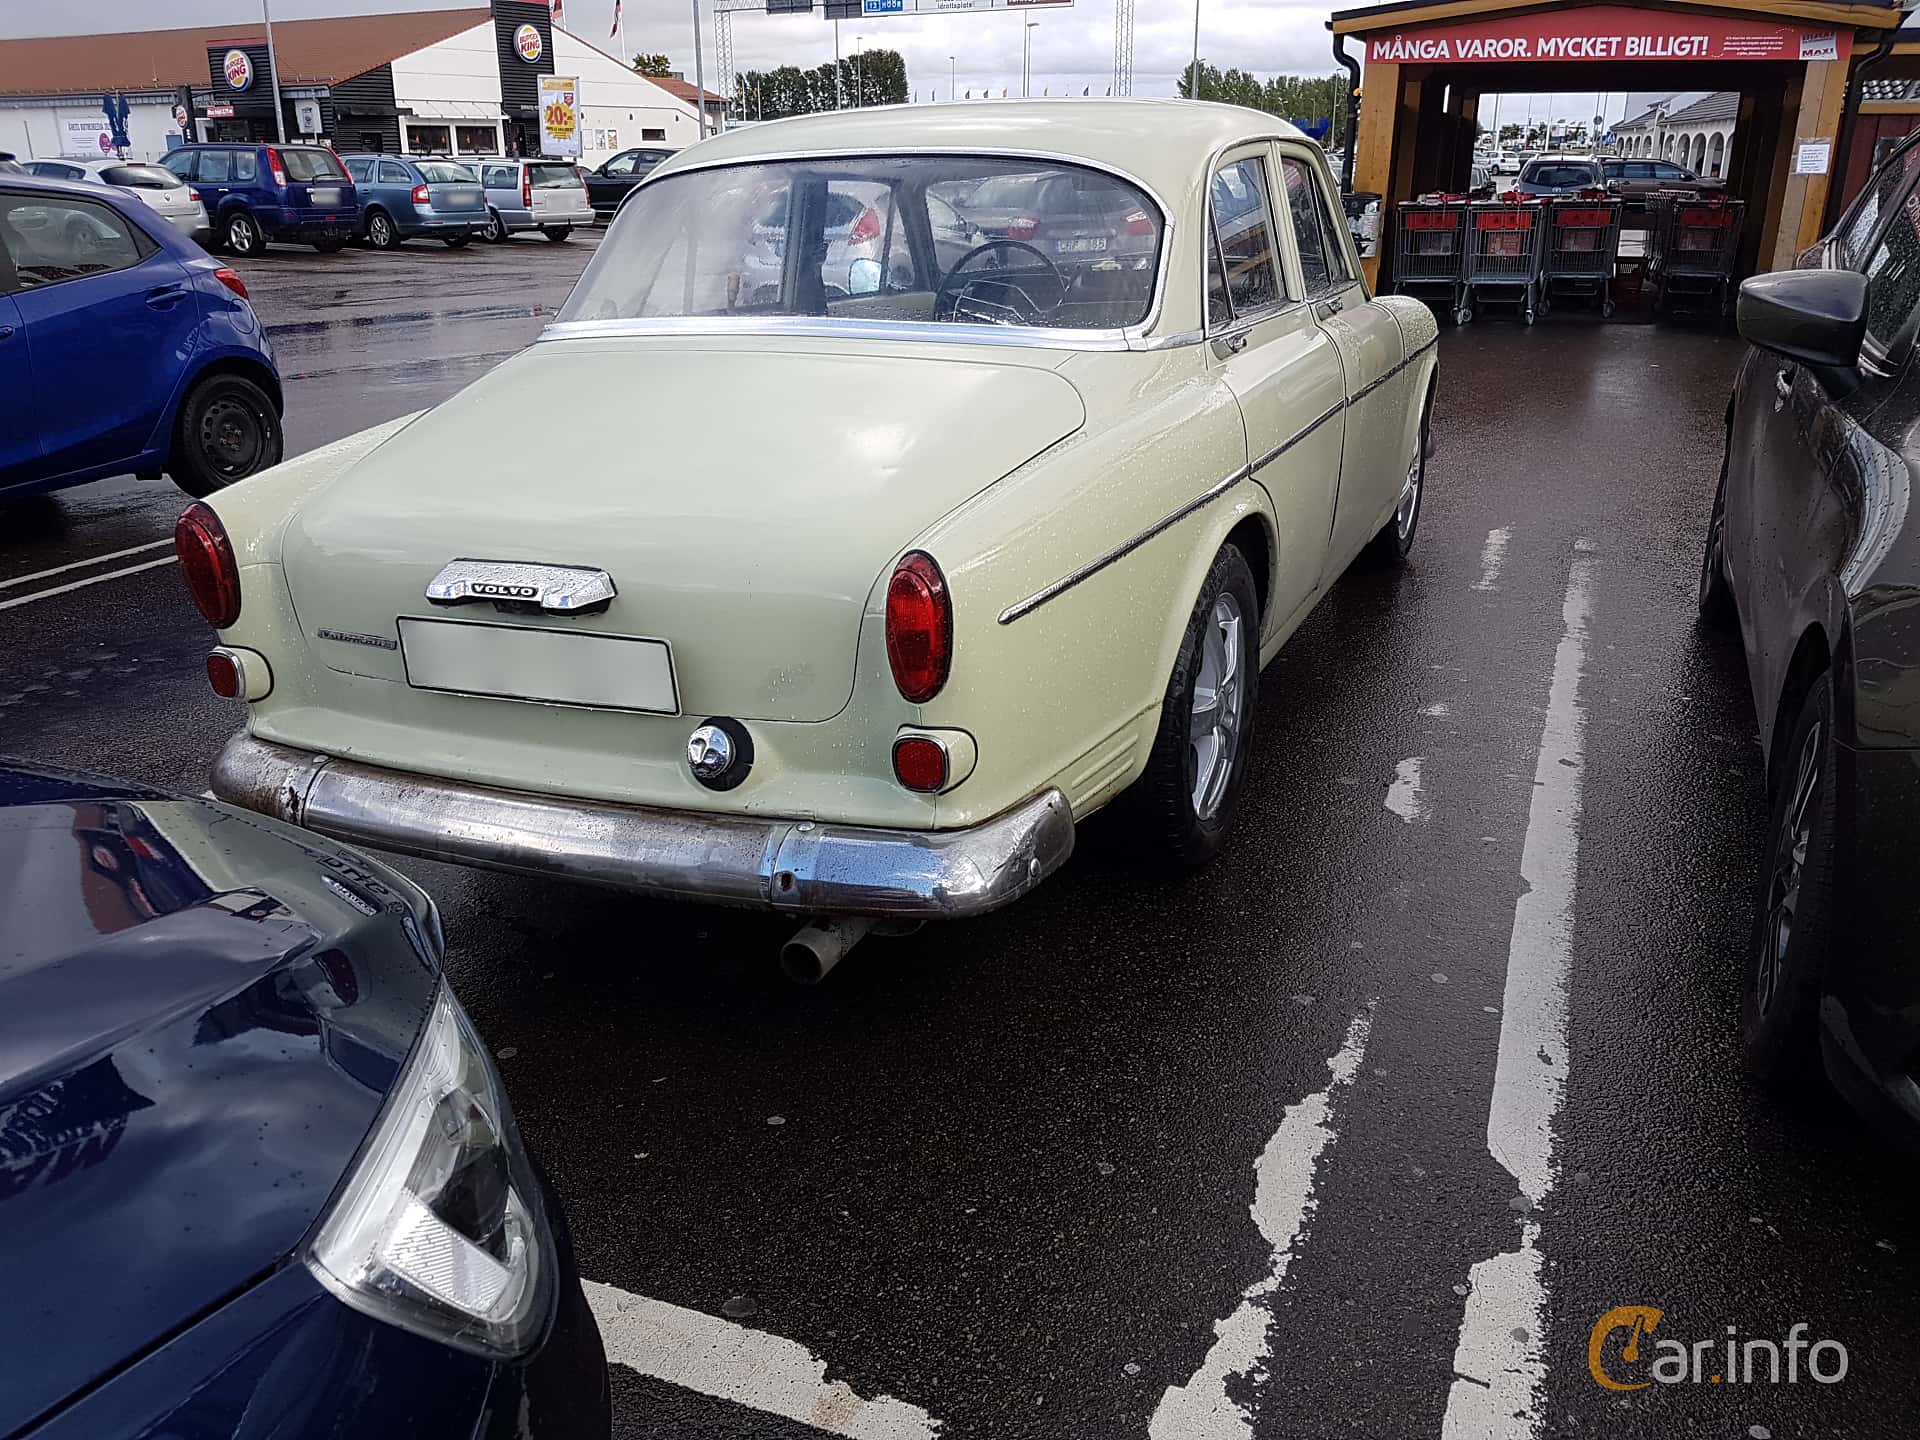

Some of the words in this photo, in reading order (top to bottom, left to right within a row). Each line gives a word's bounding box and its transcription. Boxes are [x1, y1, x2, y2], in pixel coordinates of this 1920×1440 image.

[520, 33, 538, 43] BURGER
[520, 39, 541, 53] KING
[1372, 34, 1450, 60] MÅNGA
[1455, 37, 1532, 59] VAROR.
[1536, 36, 1622, 58] MYCKET
[1624, 35, 1710, 57] BILLIGT!
[226, 57, 245, 71] BURGER
[227, 64, 247, 81] KING
[473, 584, 534, 596] VOLVO
